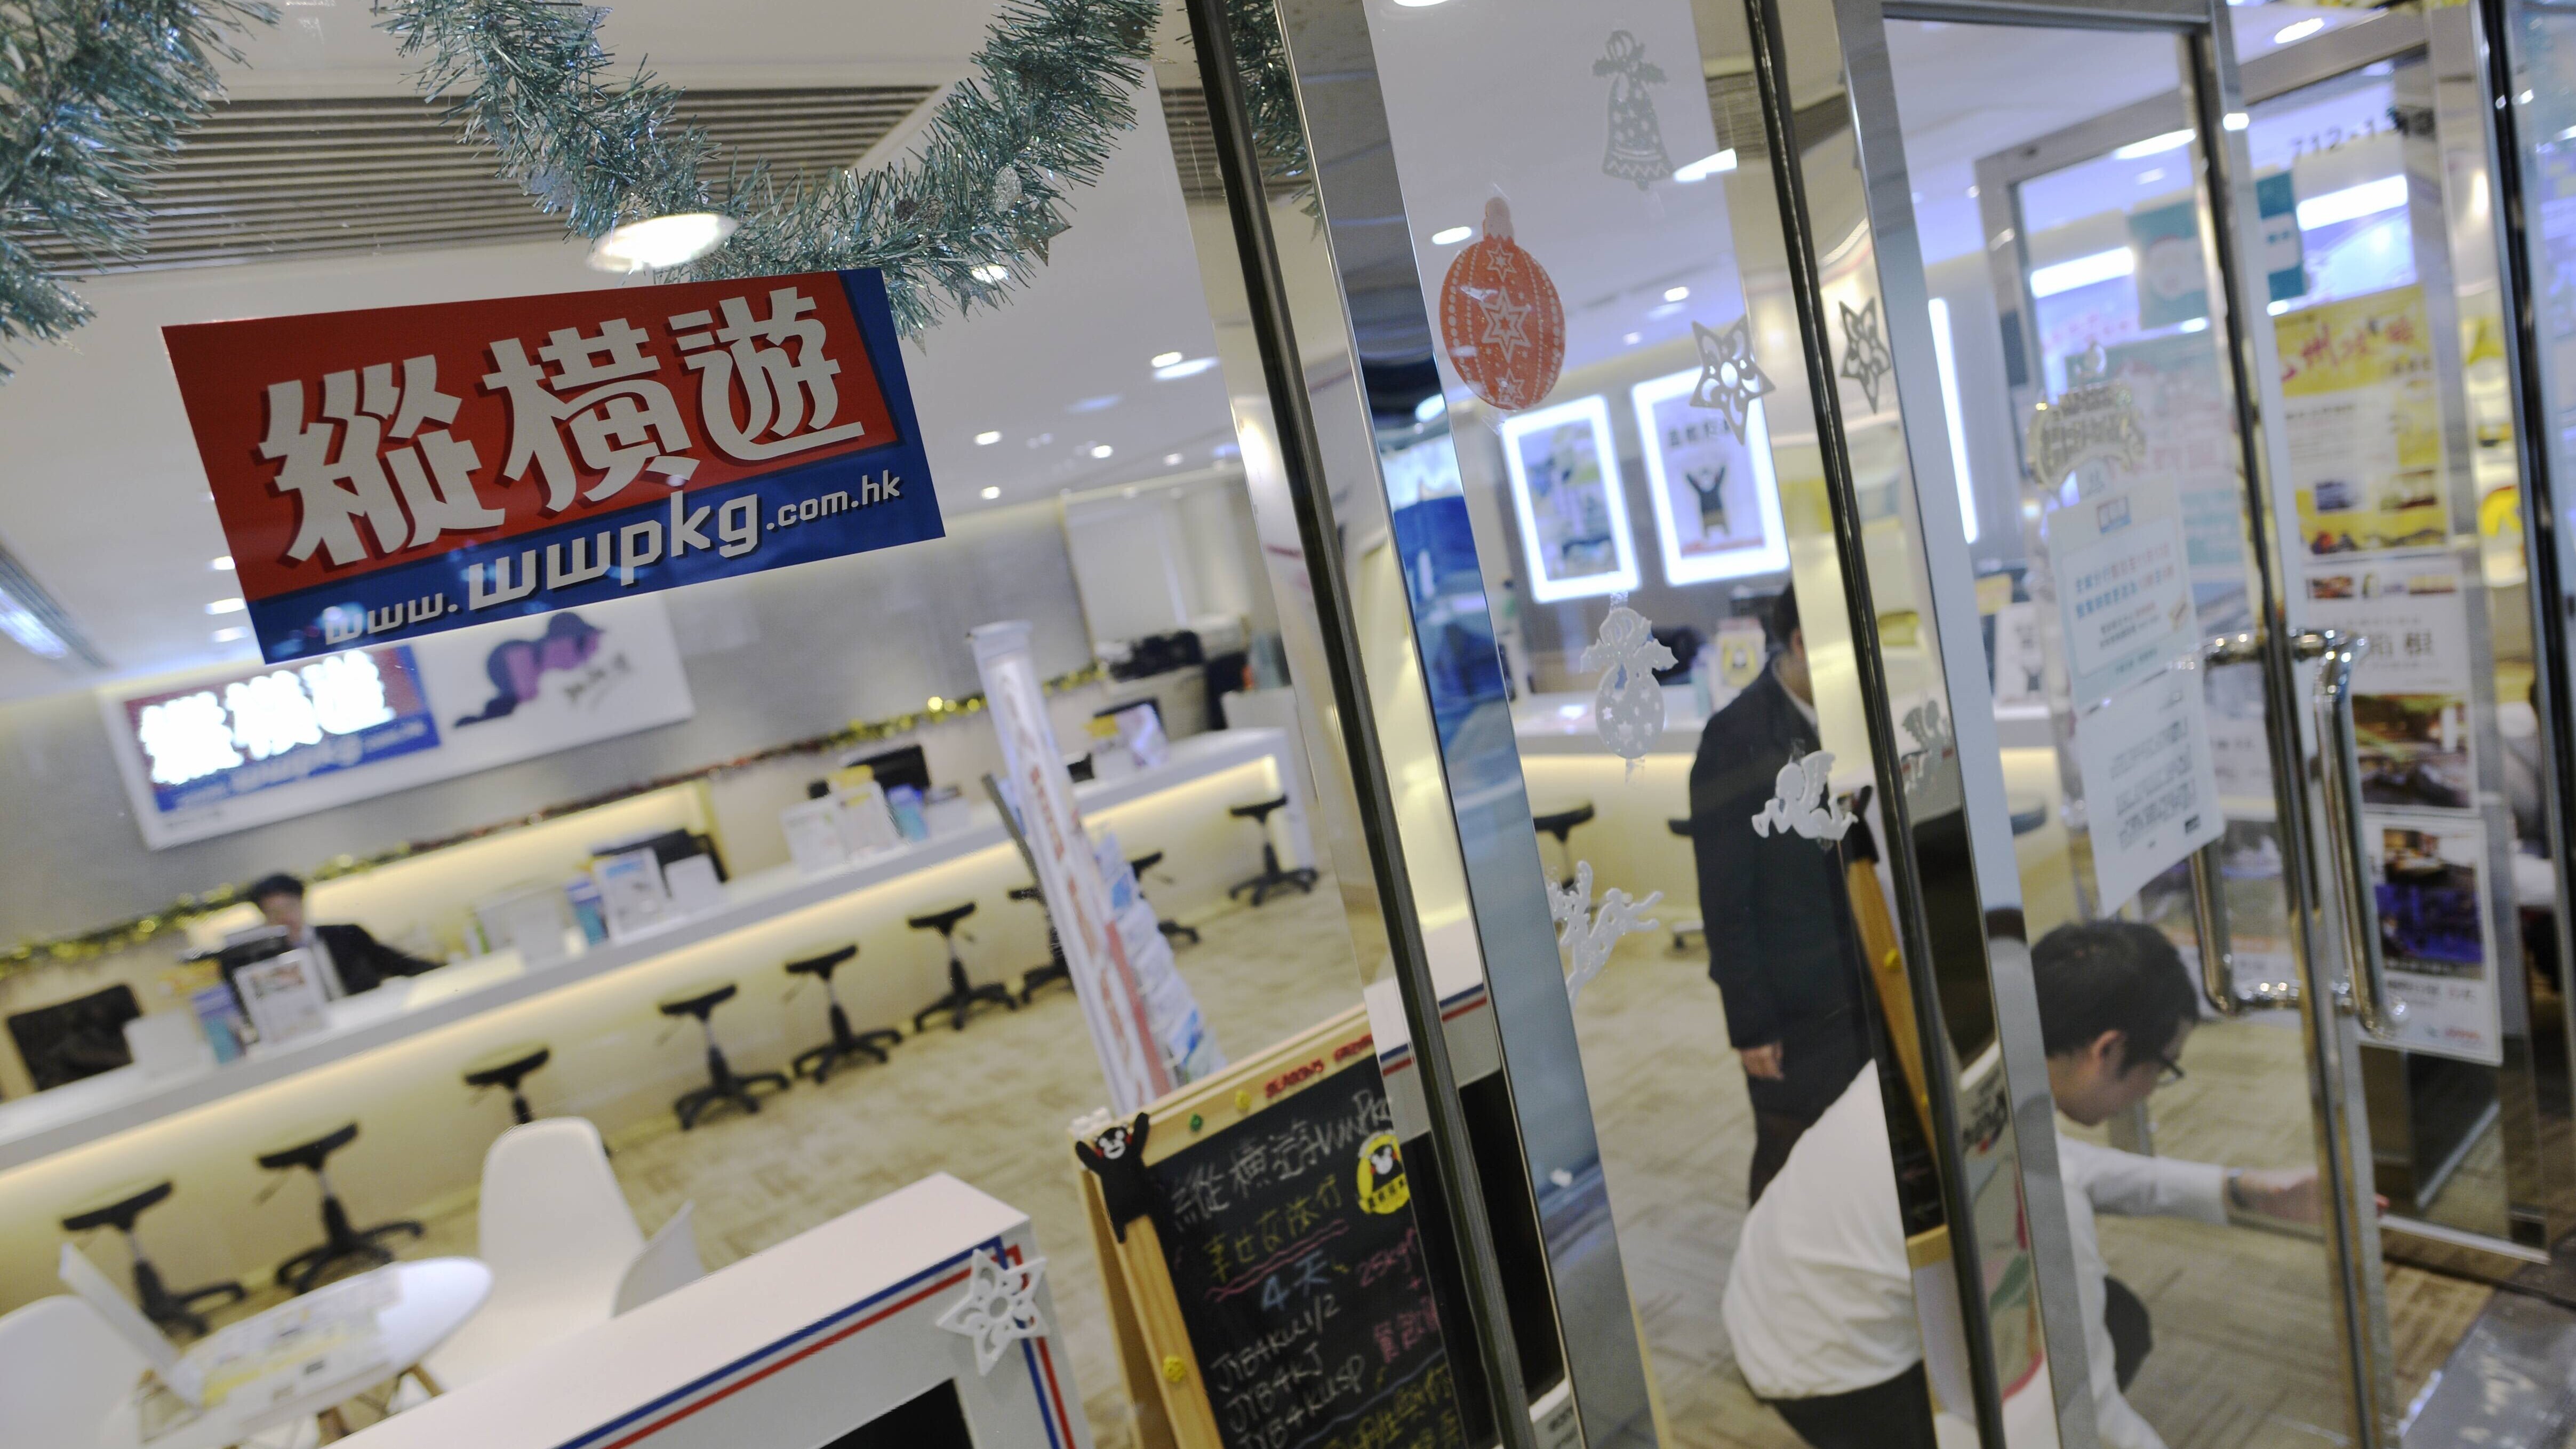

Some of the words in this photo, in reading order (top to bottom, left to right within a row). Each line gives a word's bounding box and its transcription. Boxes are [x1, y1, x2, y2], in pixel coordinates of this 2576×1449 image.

[259, 286, 865, 565] 縱橫遊
[322, 469, 900, 646] www.wwpkg.com.hk
